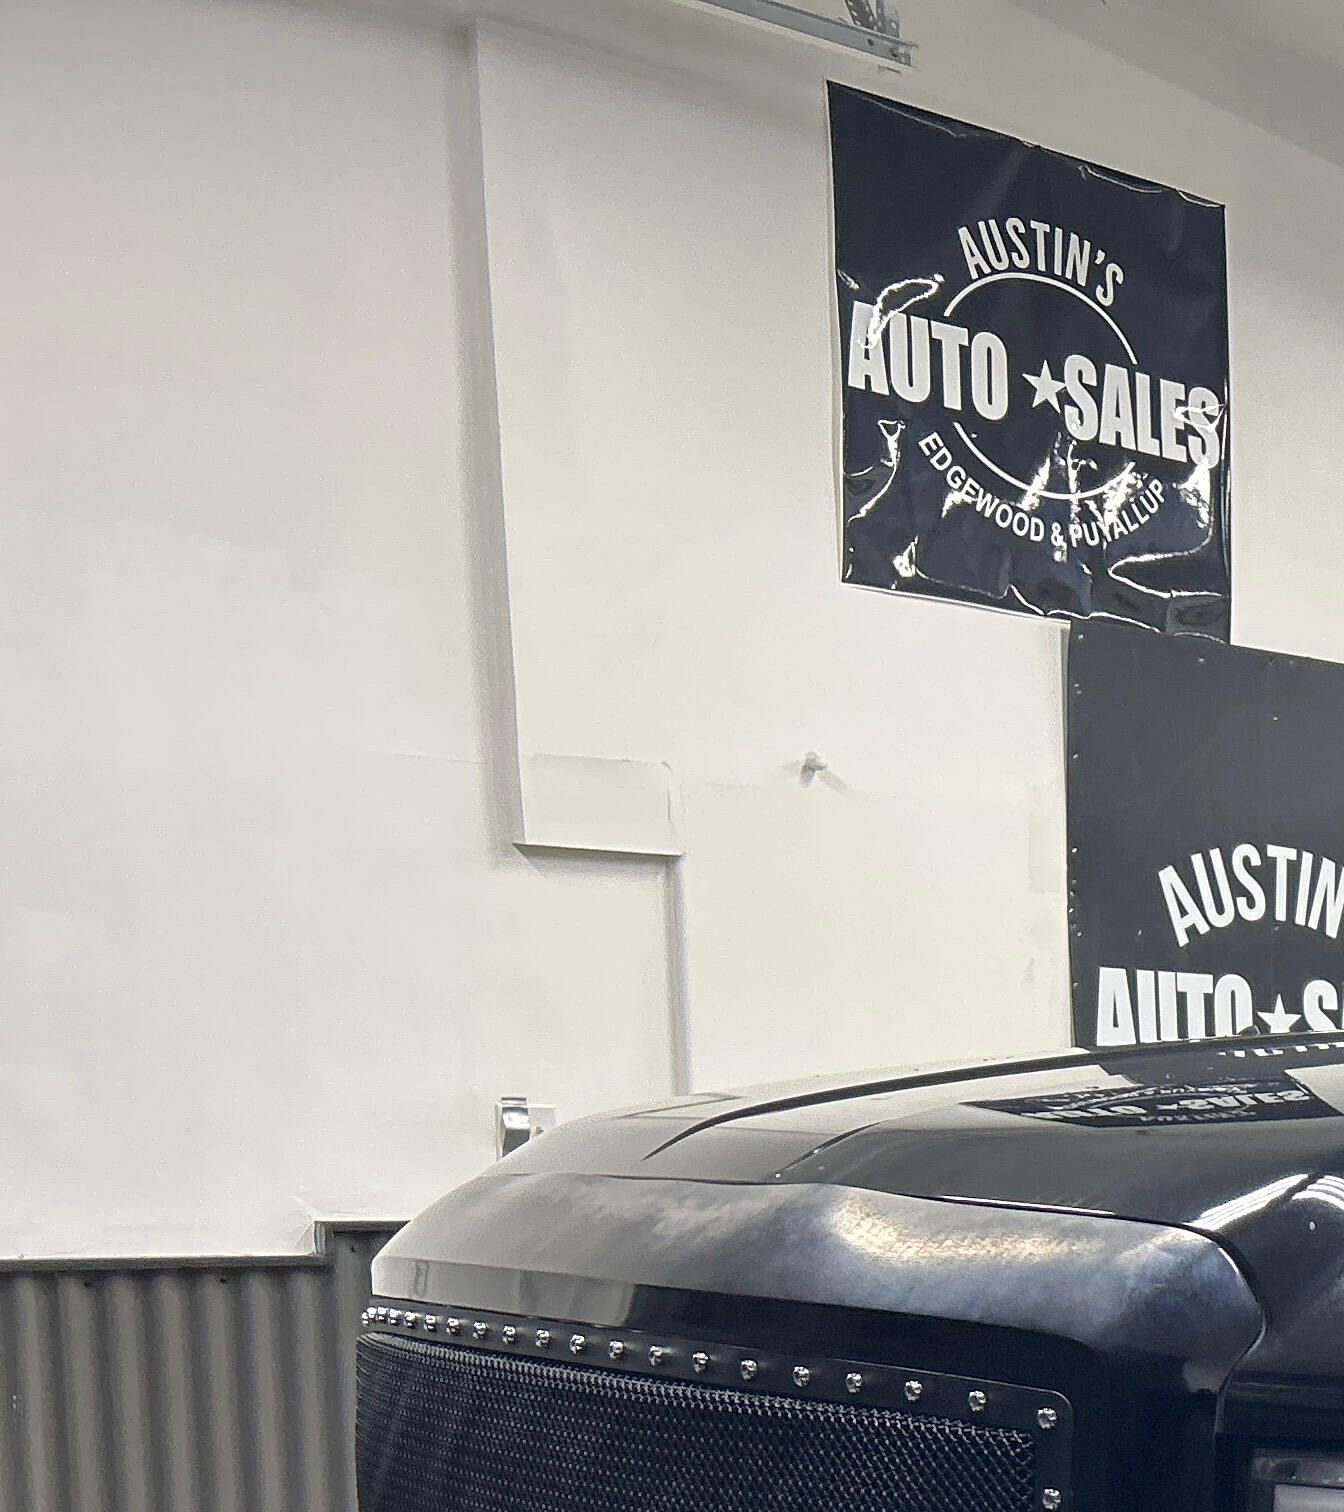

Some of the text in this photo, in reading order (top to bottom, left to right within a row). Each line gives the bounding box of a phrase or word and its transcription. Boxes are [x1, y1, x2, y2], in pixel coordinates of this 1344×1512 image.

[957, 217, 1124, 307] AUSTIN'S
[848, 300, 1223, 470] AUTO SALES
[918, 430, 1045, 544] EDGEWOOD
[1069, 480, 1166, 548] PUYALLUP
[1096, 966, 1254, 1047] AUTO
